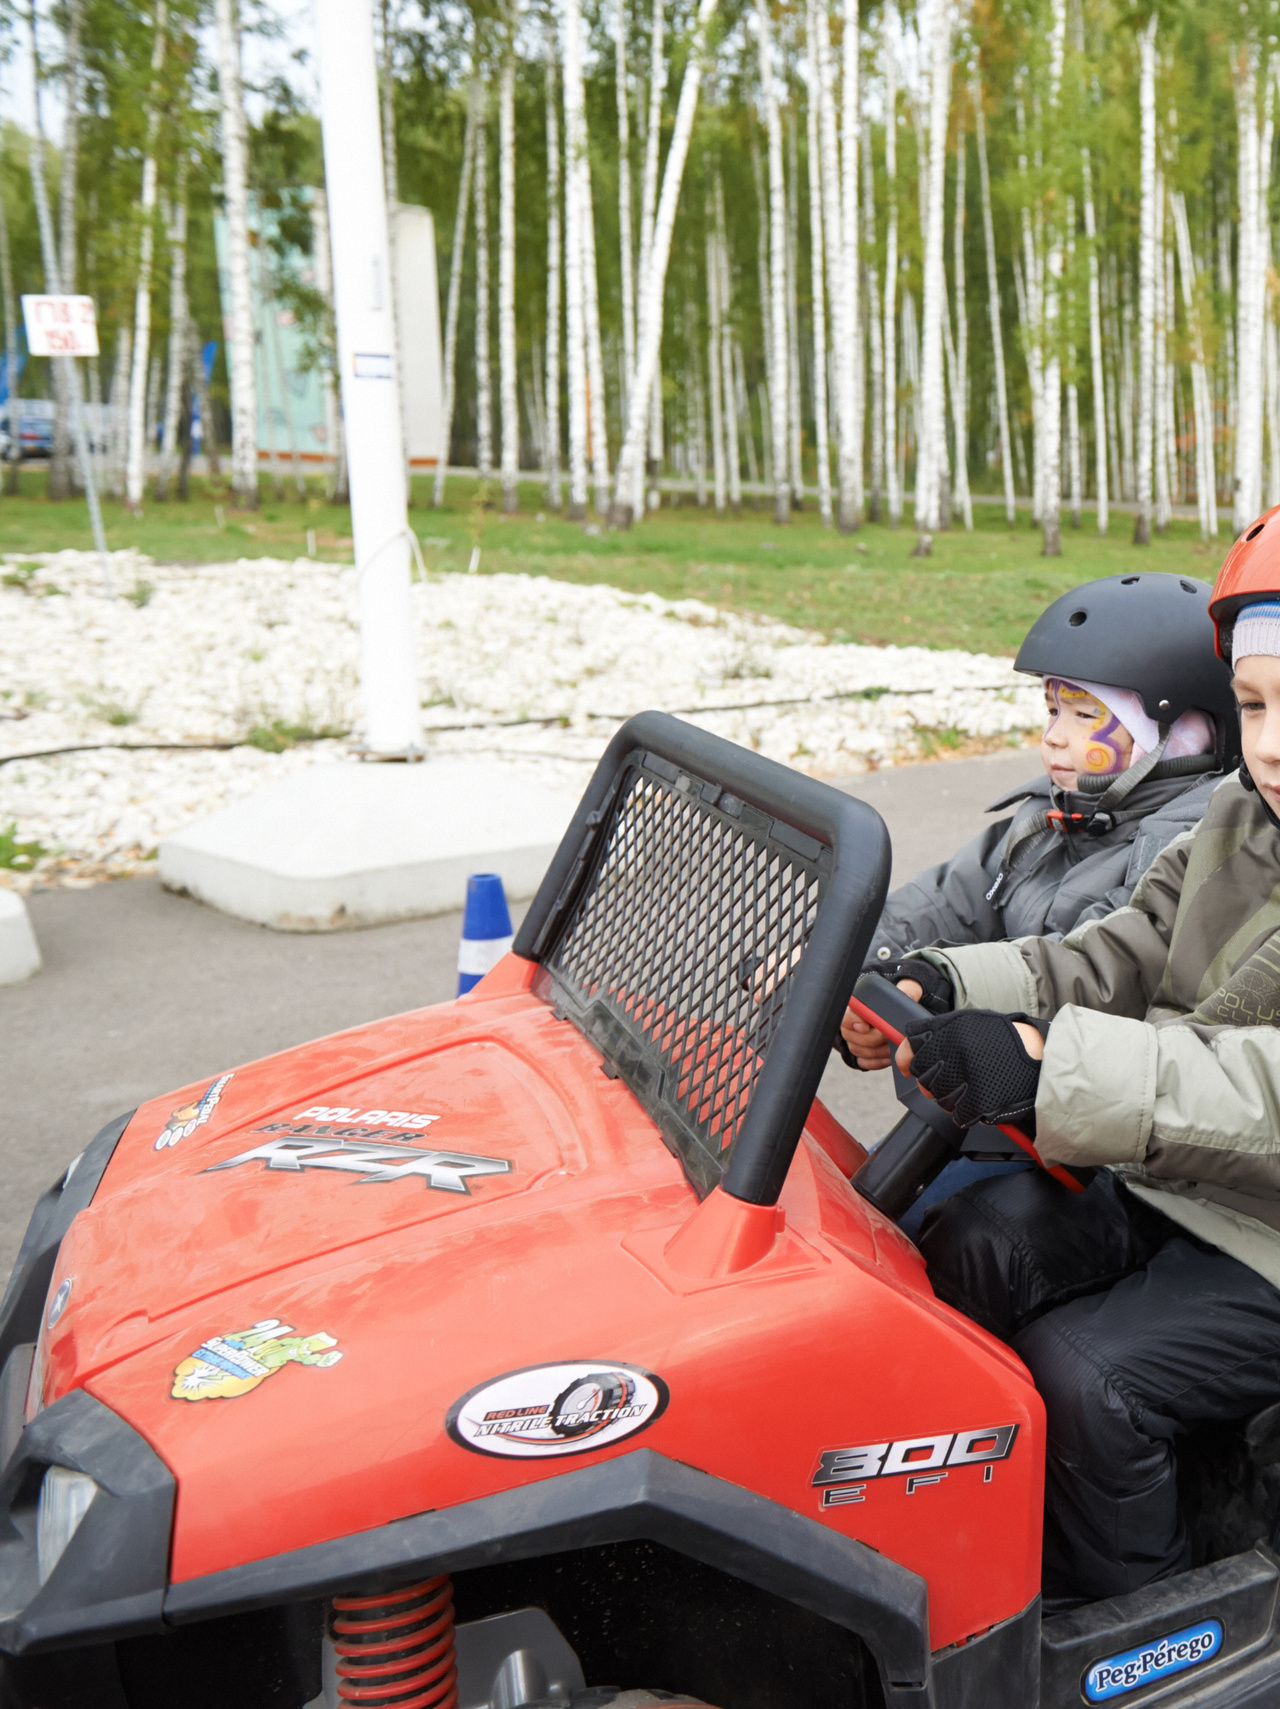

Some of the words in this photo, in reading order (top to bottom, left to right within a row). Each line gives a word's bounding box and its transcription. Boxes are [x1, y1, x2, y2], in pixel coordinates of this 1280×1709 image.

[254, 1122, 427, 1144] RANGER
[293, 1106, 440, 1130] POLARIS
[192, 1136, 514, 1196] RZR
[473, 1416, 553, 1437] NITRILE
[554, 1404, 648, 1427] TRACTION
[485, 1409, 516, 1421] RED
[517, 1405, 549, 1417] LINE
[812, 1424, 1020, 1487] 800
[822, 1465, 994, 1507] EFI
[1095, 1631, 1214, 1692] Peg-Pérego
